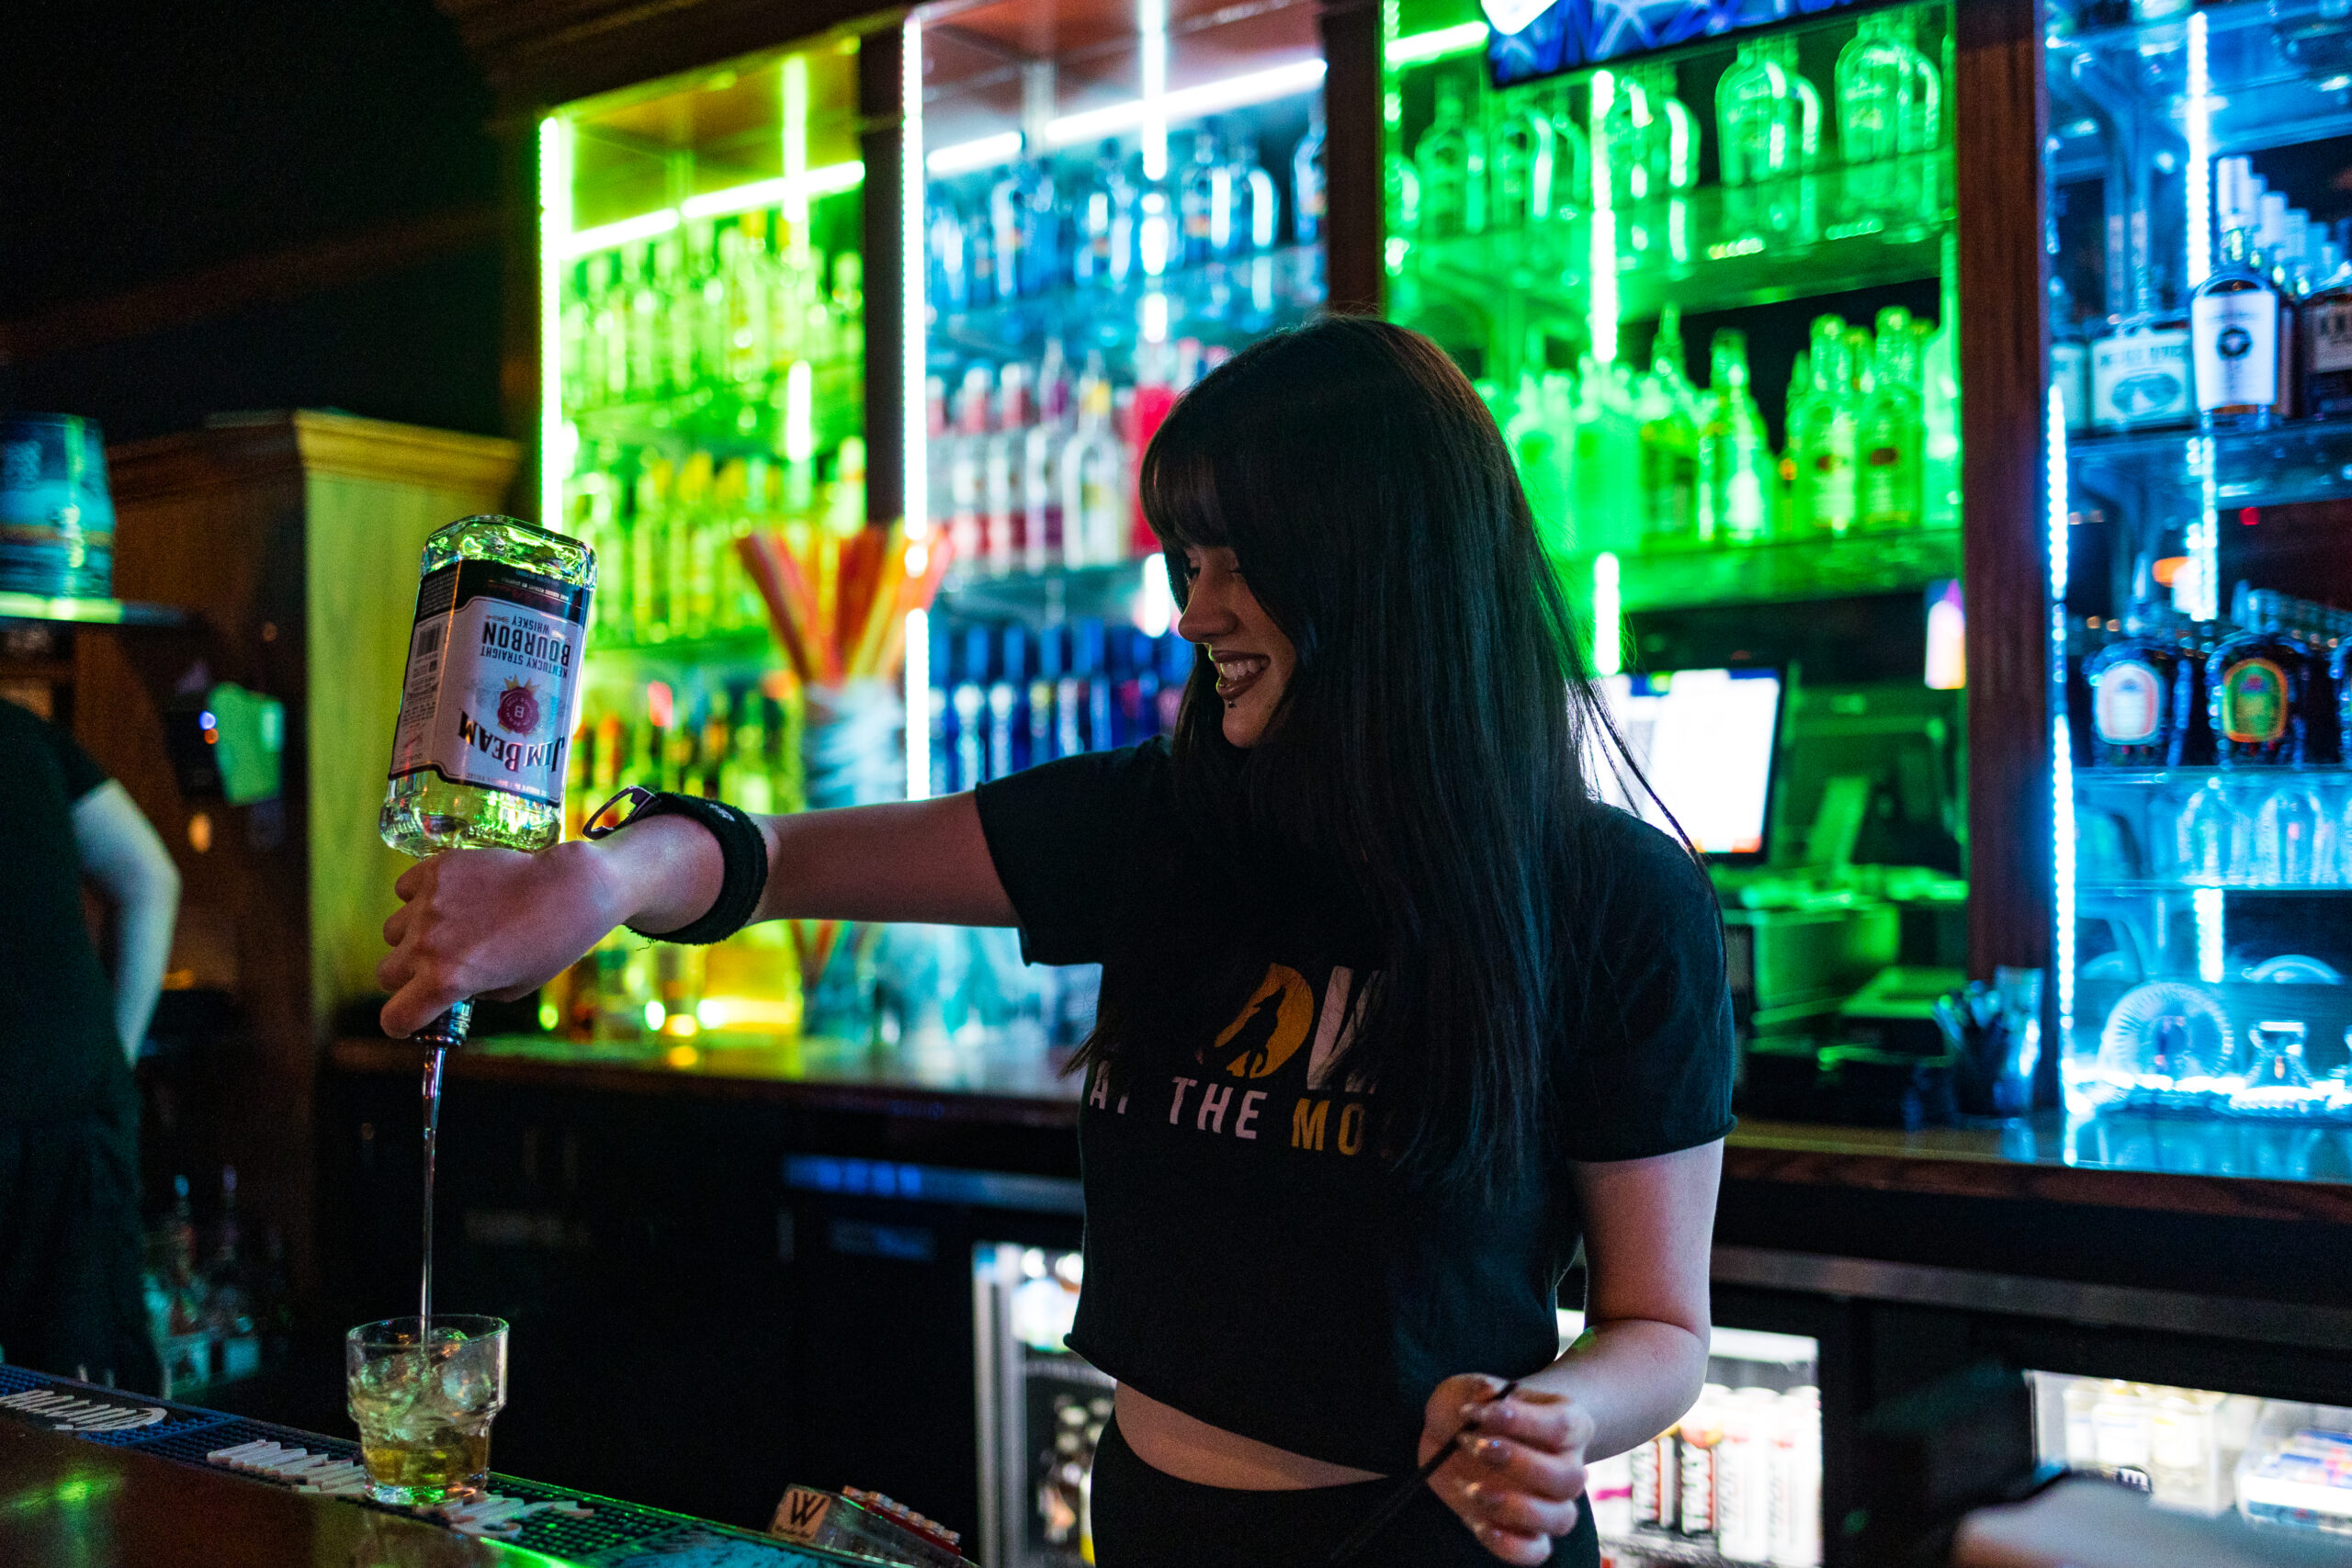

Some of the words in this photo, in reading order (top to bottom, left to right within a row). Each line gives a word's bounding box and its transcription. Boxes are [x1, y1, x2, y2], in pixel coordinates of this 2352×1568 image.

[482, 621, 571, 667] BOURBON
[512, 615, 549, 635] WHISKEY
[481, 646, 523, 665] STRAIGHT
[526, 657, 568, 679] KENTUCKY
[458, 710, 520, 773] BEAM
[523, 735, 564, 772] JIM
[1169, 1076, 1269, 1140] THE
[1682, 1441, 1713, 1535] TRULY
